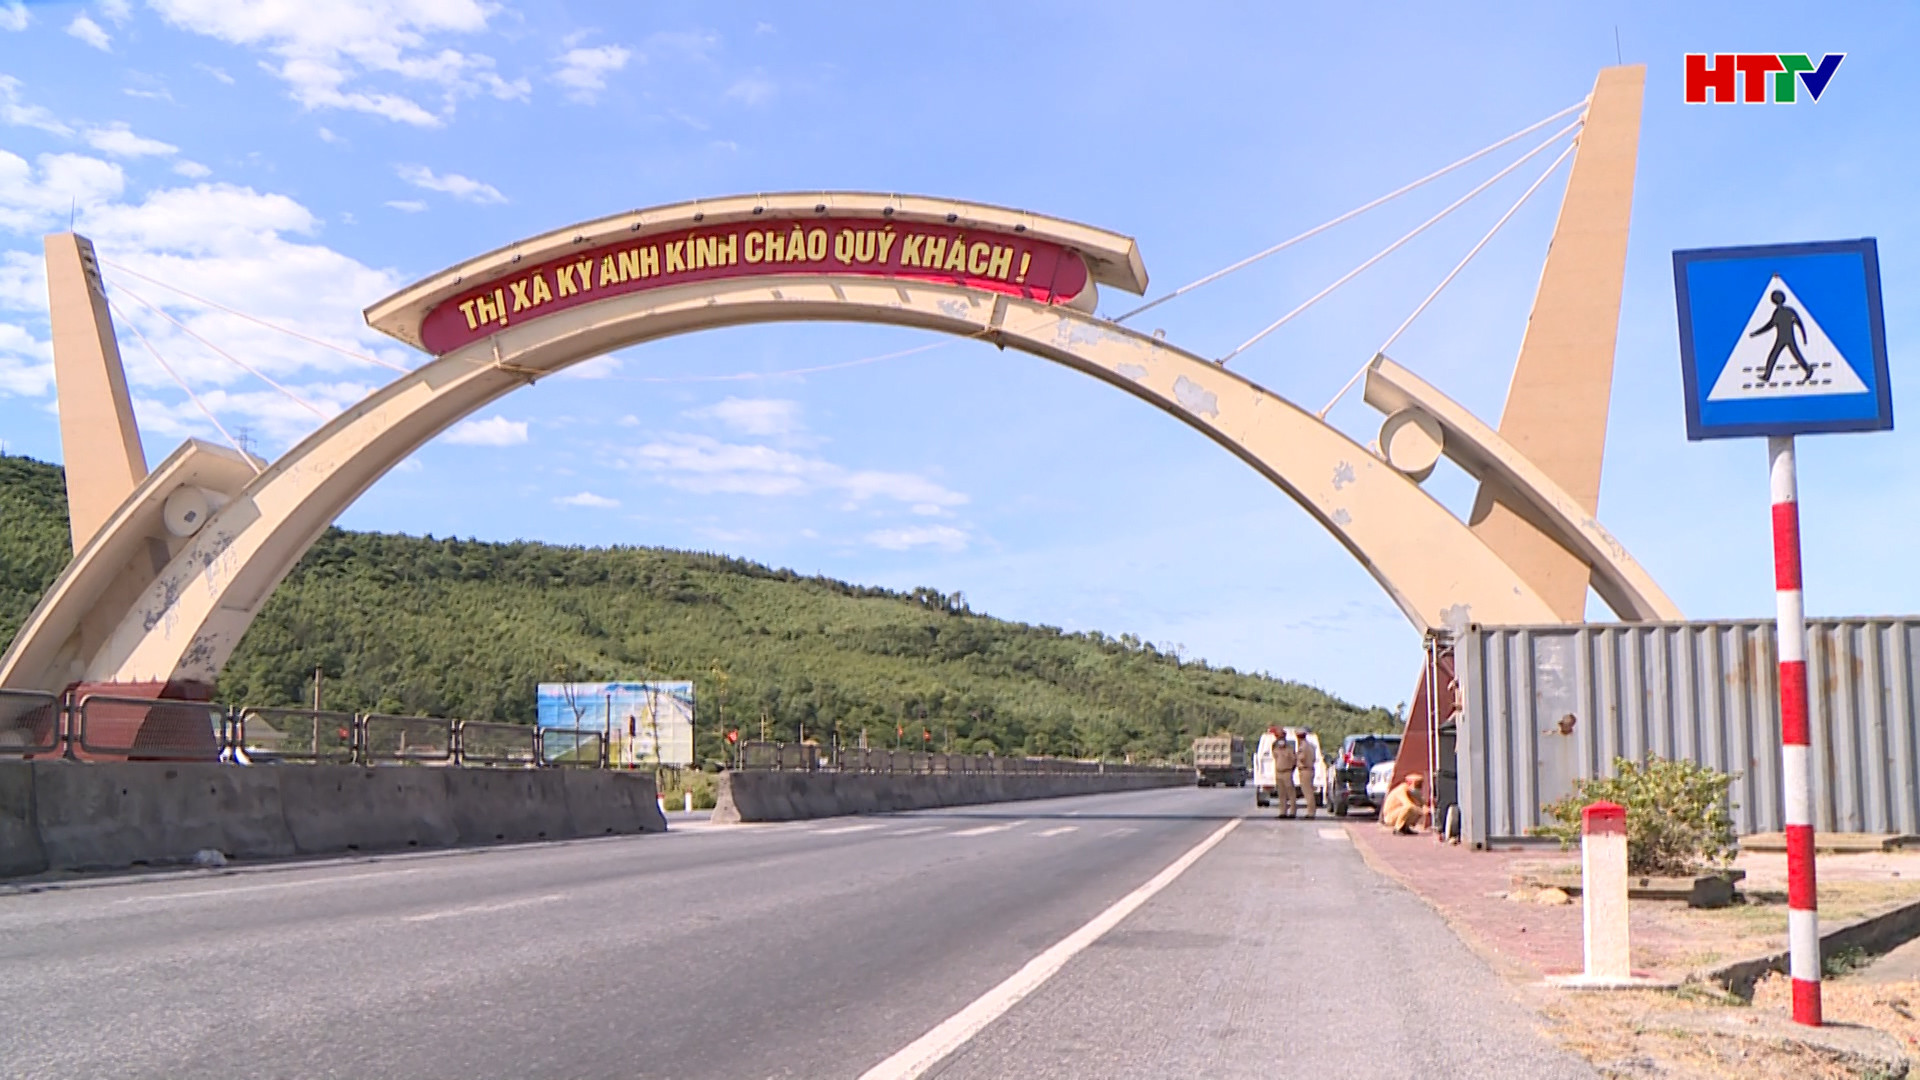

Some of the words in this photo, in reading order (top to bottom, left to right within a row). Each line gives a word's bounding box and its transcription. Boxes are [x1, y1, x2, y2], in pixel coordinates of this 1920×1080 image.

[458, 287, 508, 331] THỊ
[665, 232, 737, 273] KÍNH
[744, 223, 828, 262] CHÀO
[834, 225, 896, 264] QUÝ
[901, 234, 1014, 279] KHÁCH
